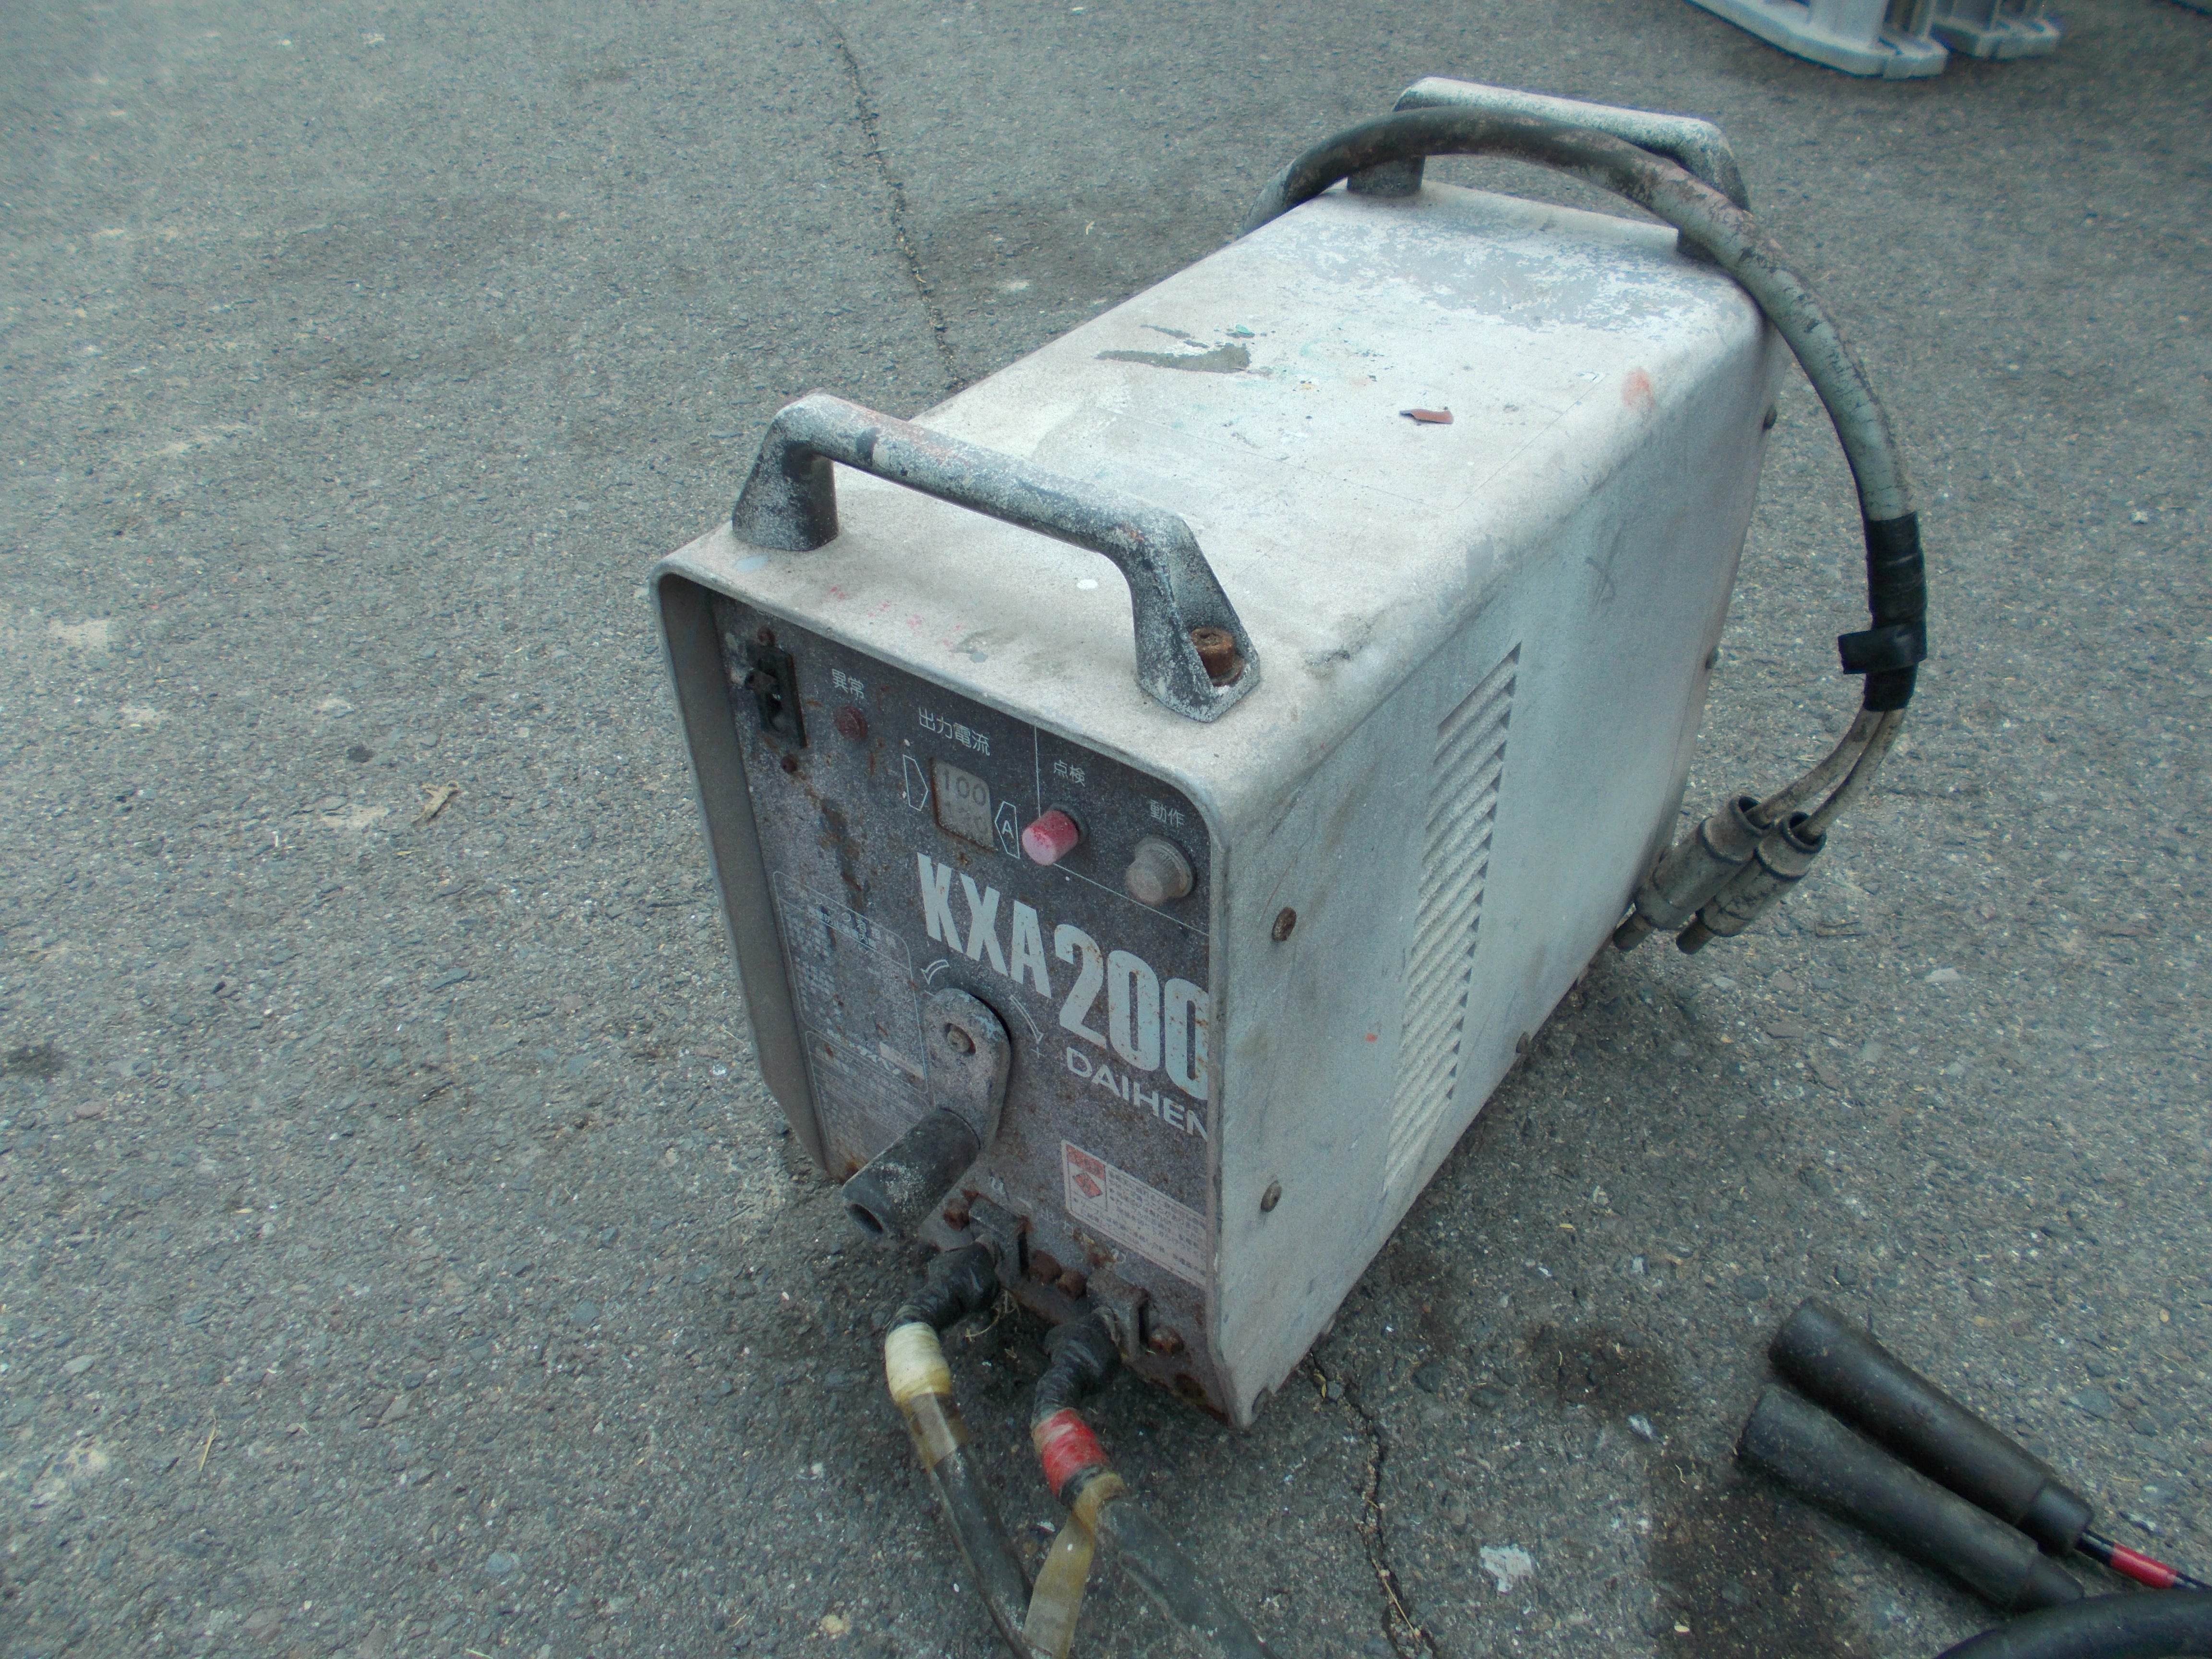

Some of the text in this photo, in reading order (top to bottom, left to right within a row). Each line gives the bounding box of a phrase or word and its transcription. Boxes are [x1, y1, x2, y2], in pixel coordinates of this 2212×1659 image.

[831, 668, 865, 699] 異常
[918, 706, 990, 757] 出力電流
[943, 769, 987, 806] 100
[1053, 759, 1086, 788] 点検
[1001, 820, 1015, 839] A
[1150, 799, 1185, 828] 動作
[916, 852, 1209, 1101] KXA200
[1066, 1046, 1208, 1142] DAIHEN
